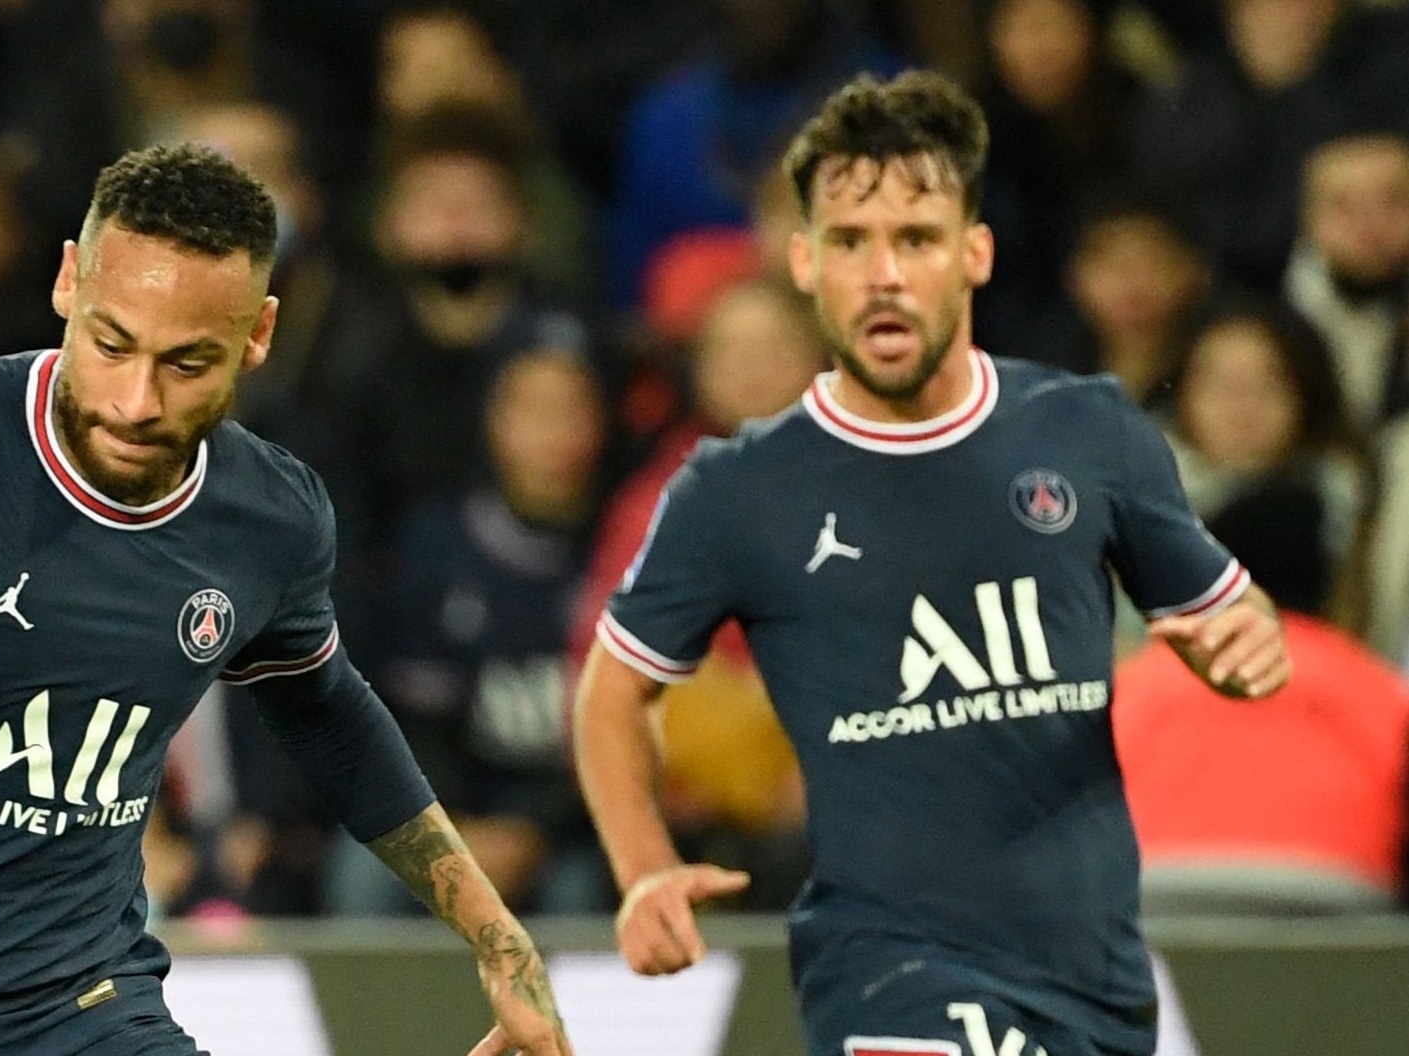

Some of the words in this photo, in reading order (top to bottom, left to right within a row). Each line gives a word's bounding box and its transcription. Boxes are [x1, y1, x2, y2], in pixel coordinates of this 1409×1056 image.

[191, 592, 230, 615] PARIS
[827, 702, 937, 744] ACCOR
[935, 690, 1004, 729] LIVE
